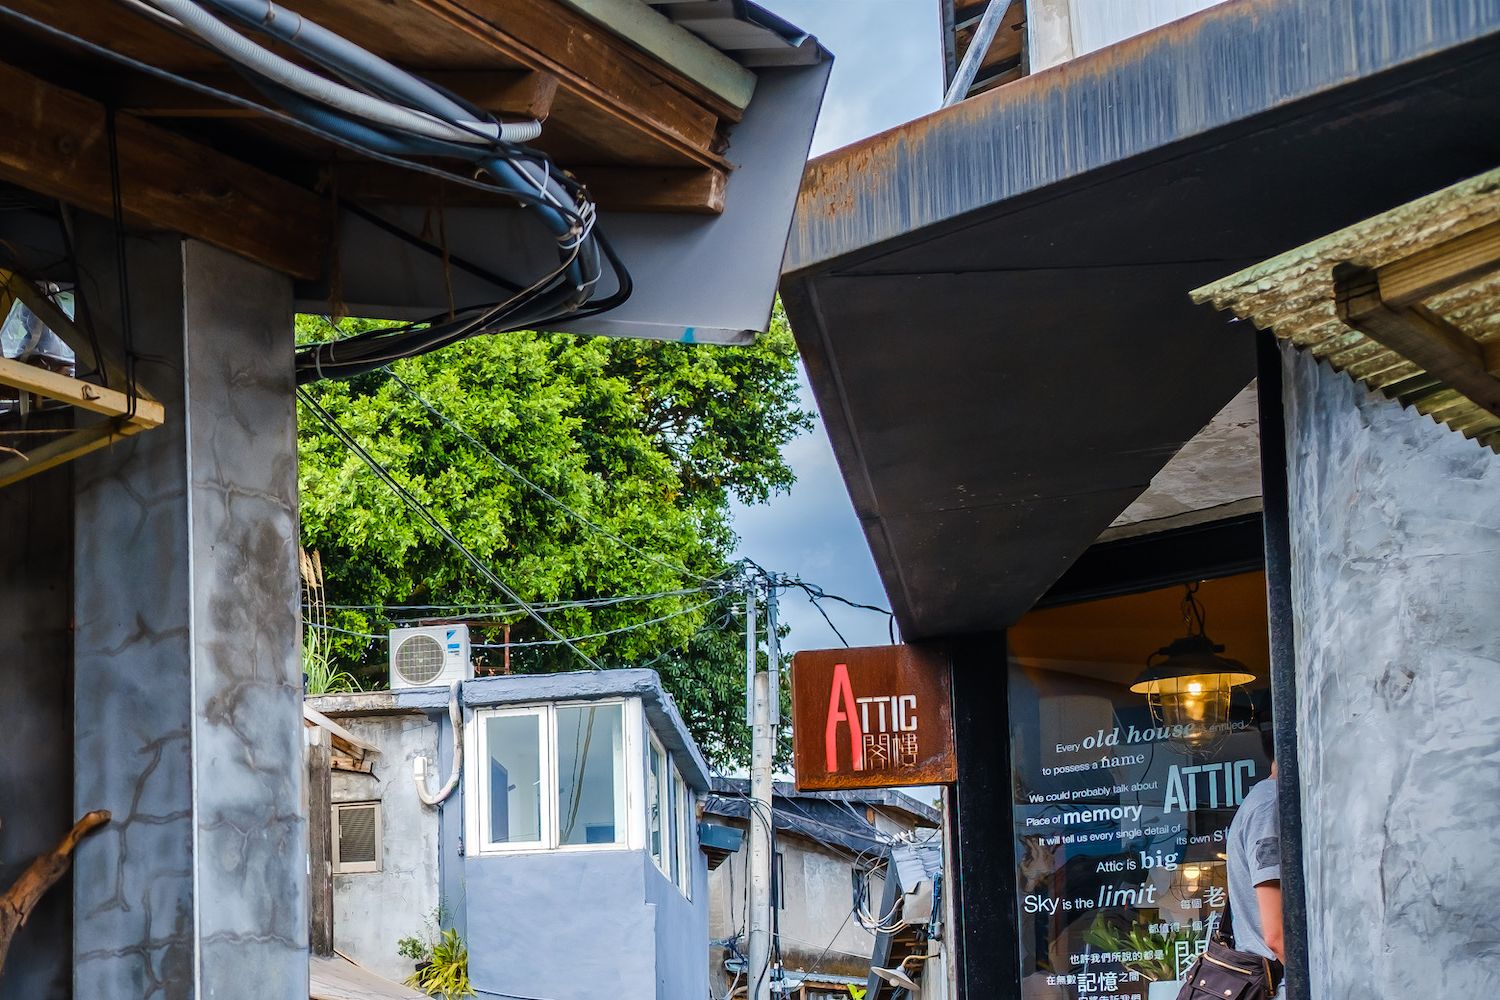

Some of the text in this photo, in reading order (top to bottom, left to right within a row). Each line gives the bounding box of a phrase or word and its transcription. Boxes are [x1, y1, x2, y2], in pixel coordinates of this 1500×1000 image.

[825, 663, 918, 773] ATTIC
[1055, 743, 1081, 753] Every
[1082, 727, 1120, 750] old
[1126, 723, 1196, 744] house
[1042, 754, 1145, 776] to possess a name
[1029, 780, 1158, 804] We could probably talk about
[1163, 759, 1256, 814] ATTIC
[1026, 804, 1143, 827] Place of memory
[1038, 823, 1182, 847] It will tell us every single detail of
[1176, 837, 1188, 845] its
[1189, 835, 1211, 844] own
[1096, 849, 1179, 873] Attic is big
[1023, 882, 1157, 916] Sky is the limit
[1069, 949, 1165, 966] 也許我們所說的都是
